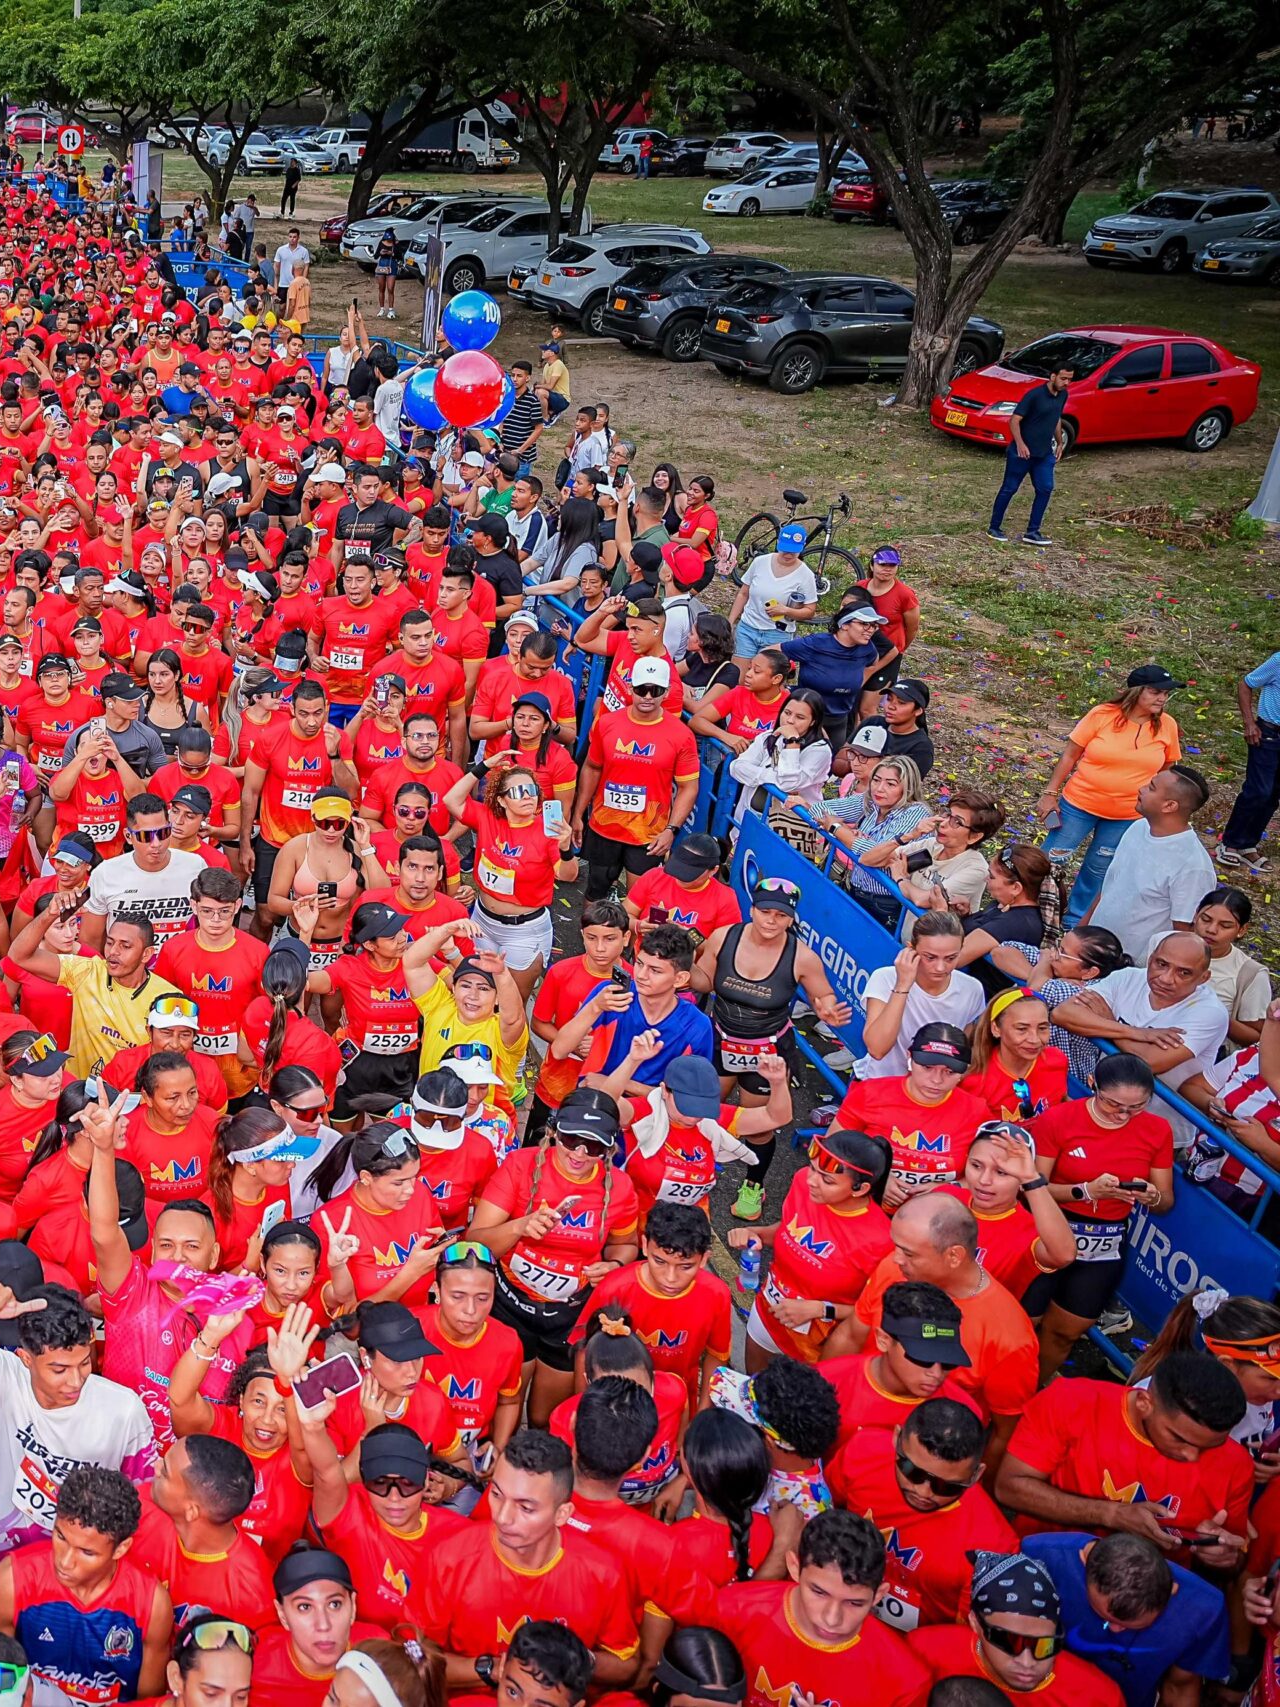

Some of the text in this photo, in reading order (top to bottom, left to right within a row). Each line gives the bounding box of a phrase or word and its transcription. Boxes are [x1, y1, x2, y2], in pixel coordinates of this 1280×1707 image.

[333, 653, 357, 665] 2154
[609, 792, 639, 806] 1235
[83, 822, 116, 837] 2399
[486, 871, 498, 884] 17
[192, 1035, 230, 1049] 2012
[369, 1035, 411, 1049] 2529
[519, 1262, 570, 1292] 2777
[1135, 1256, 1168, 1293] Red de
[464, 1418, 476, 1426] 5K
[894, 1585, 909, 1598] 5K
[98, 1689, 112, 1698] 5K
